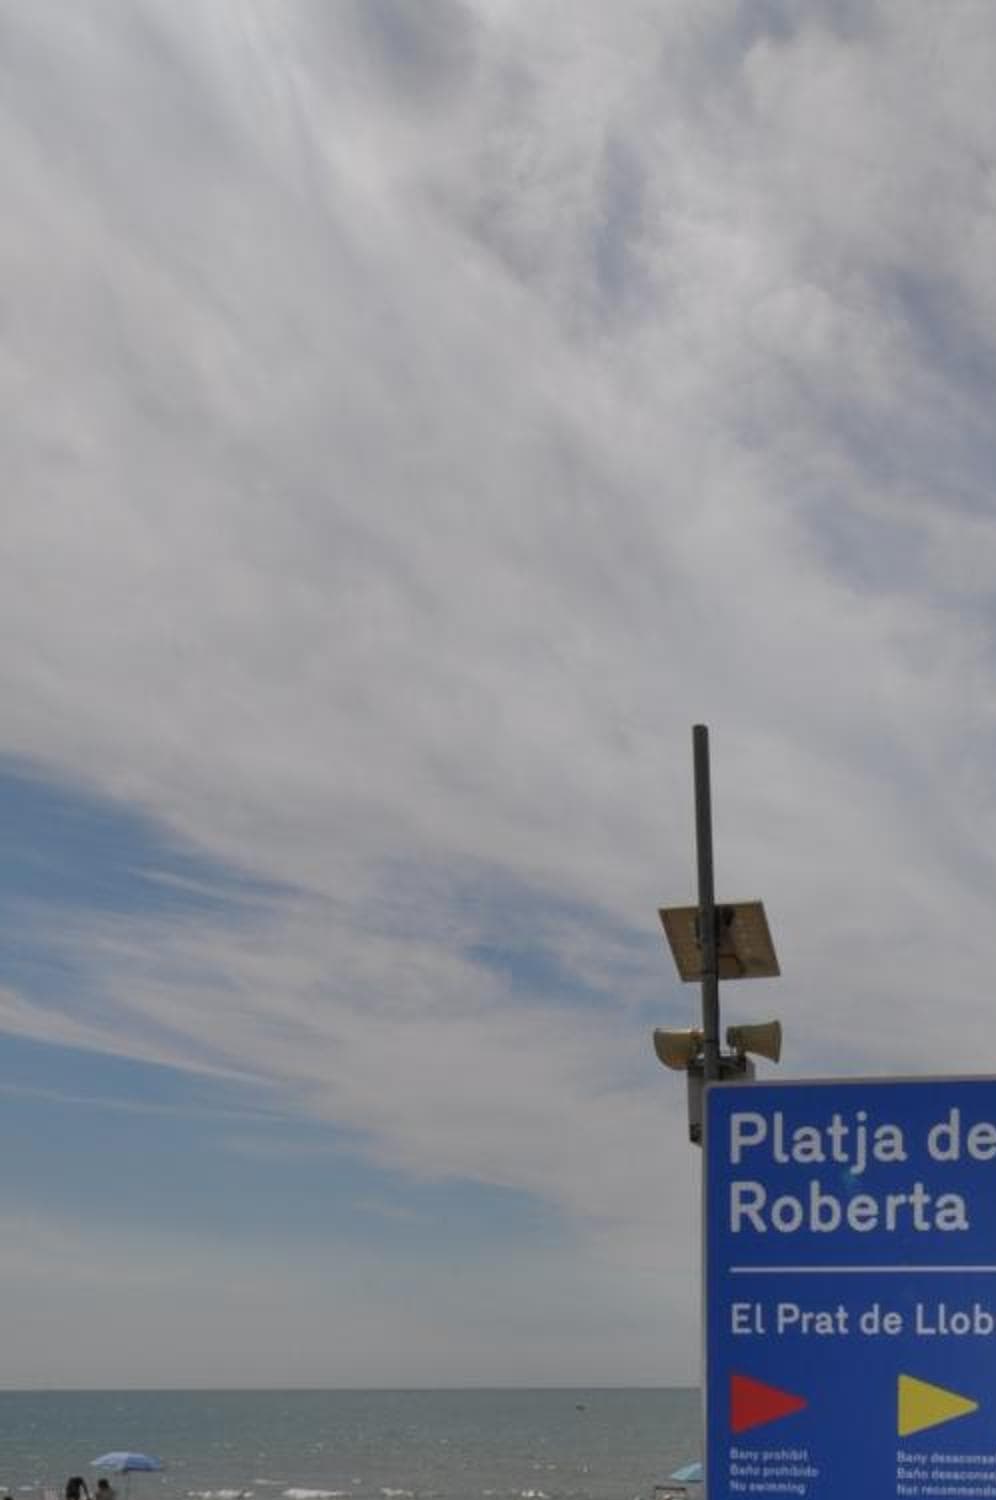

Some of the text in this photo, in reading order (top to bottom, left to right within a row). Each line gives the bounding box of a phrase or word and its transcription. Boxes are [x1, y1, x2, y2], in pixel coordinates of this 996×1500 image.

[730, 1111, 906, 1175] Platja
[730, 1180, 969, 1233] Roberta
[731, 1304, 765, 1335] El
[776, 1304, 848, 1335] Prat
[859, 1303, 903, 1335] de
[897, 1449, 928, 1464] Bany
